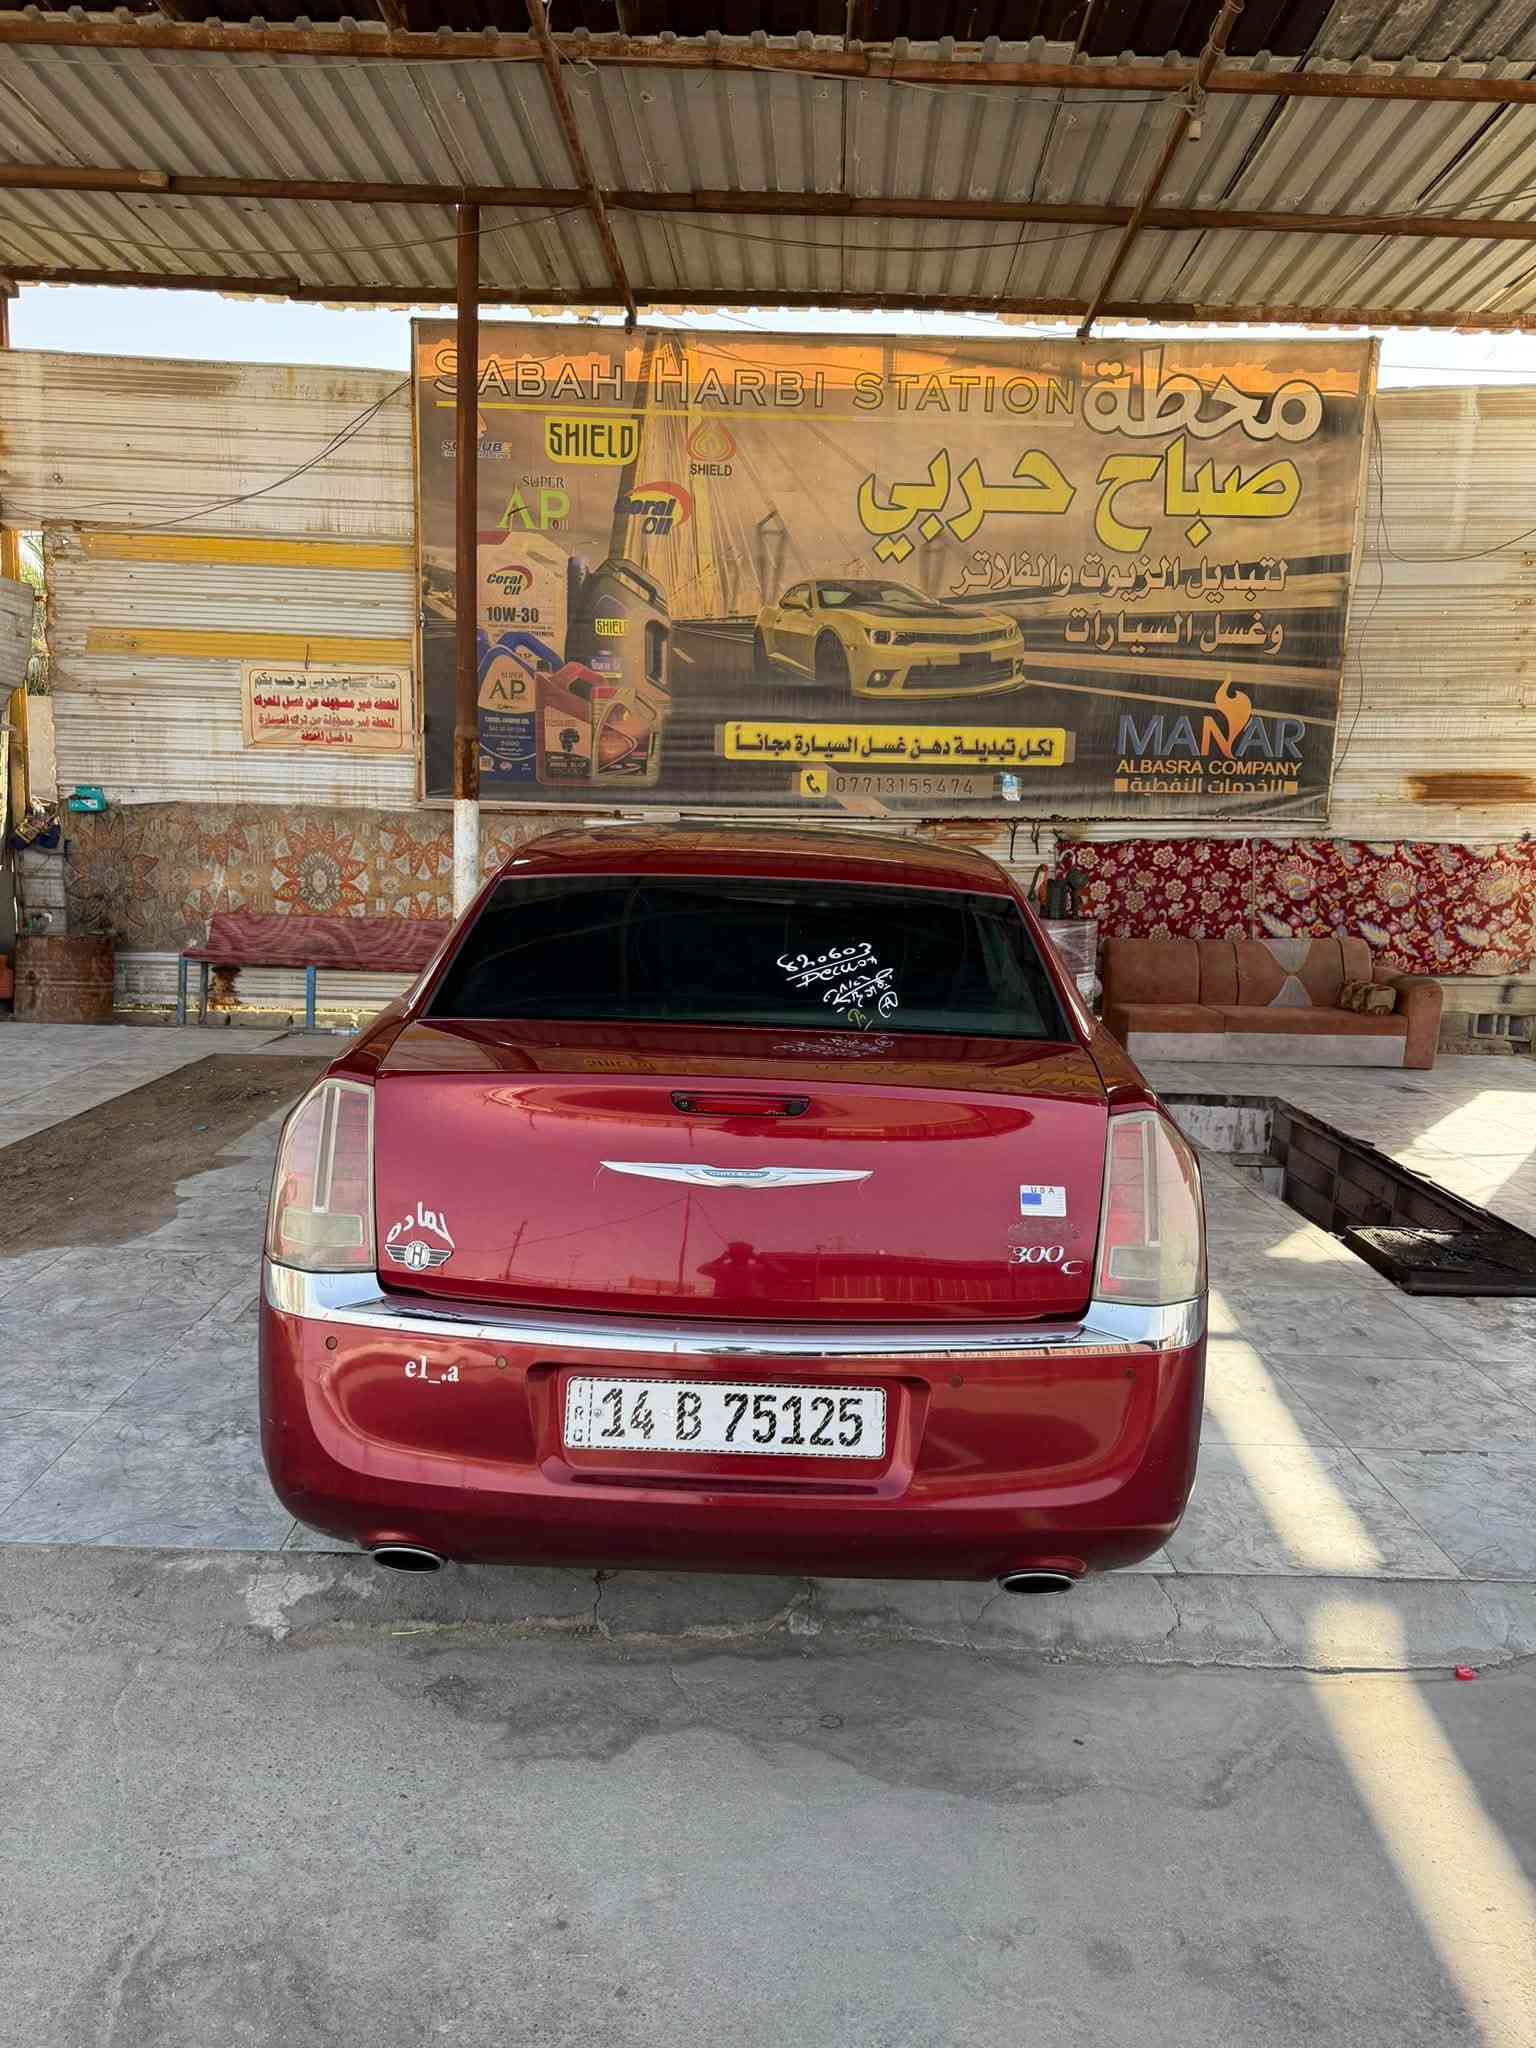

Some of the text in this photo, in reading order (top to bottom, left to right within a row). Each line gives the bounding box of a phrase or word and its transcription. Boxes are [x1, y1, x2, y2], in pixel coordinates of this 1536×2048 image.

[654, 357, 825, 409] HARBI
[853, 371, 1076, 415] STATION
[1082, 343, 1325, 443] محطة
[549, 421, 634, 459] SHIELD
[689, 463, 733, 478] SHIELD
[521, 475, 566, 489] SUPER
[496, 482, 571, 529] AP
[613, 496, 677, 516] Coral
[857, 433, 1303, 562] صباح حربي
[486, 573, 523, 585] Coral
[950, 550, 1289, 603] لتبديل الزيوت والفلاتر
[486, 606, 540, 624] 10W-30
[597, 620, 624, 634] SHIEL
[1064, 608, 1285, 656] وغسل السيارات
[489, 679, 526, 700] AP
[795, 733, 857, 758] السيارة
[862, 735, 906, 758] غسل
[1117, 714, 1306, 759] MANAR
[910, 738, 951, 759] دهن
[954, 736, 1016, 762] تبديلة
[1018, 738, 1054, 760] لكل
[1116, 759, 1303, 777] ALBASRA COMPANY
[834, 775, 974, 795] 07713155474
[1130, 777, 1283, 796] للخدمات النفطية
[1030, 1186, 1056, 1194] USA
[1009, 1245, 1065, 1264] 300
[1061, 1260, 1085, 1275] C
[601, 1387, 864, 1447] 14 B 75125
